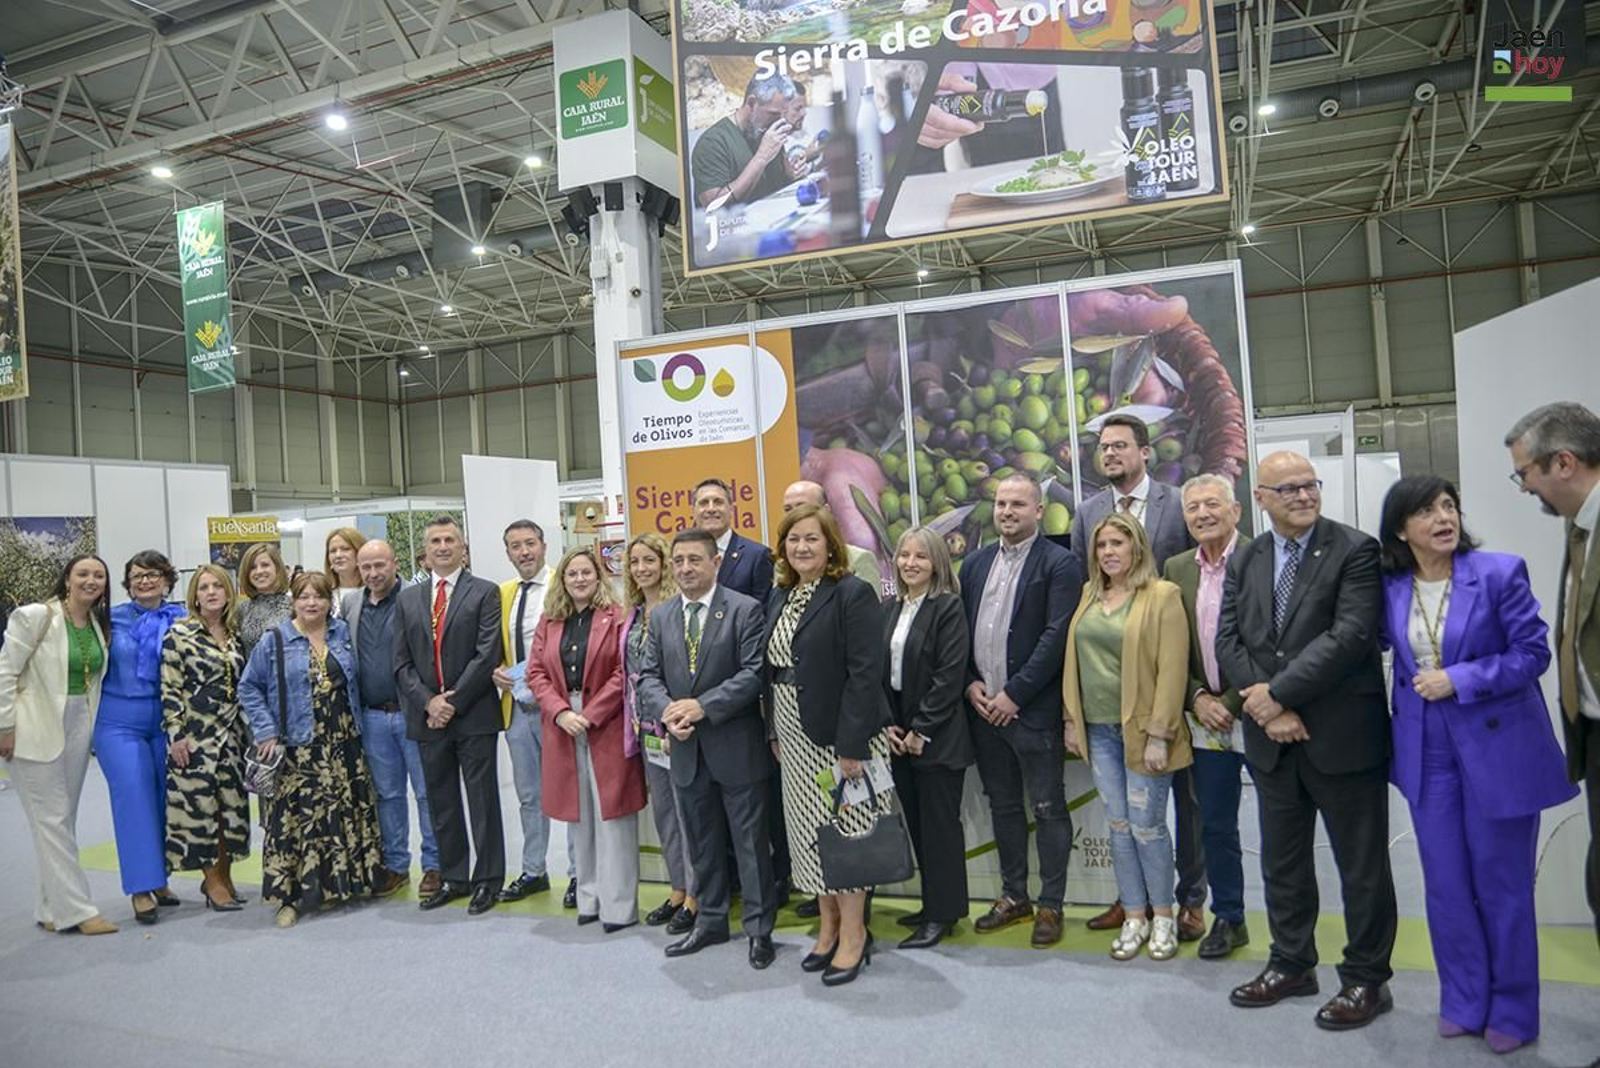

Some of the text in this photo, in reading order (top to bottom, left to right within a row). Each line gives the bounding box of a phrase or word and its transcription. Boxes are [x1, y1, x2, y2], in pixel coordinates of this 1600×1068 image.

[753, 0, 1107, 82] Sierra de Cazorla
[589, 95, 625, 112] RURAL
[1144, 135, 1195, 155] OLEO
[1147, 150, 1196, 169] TOUR
[642, 414, 693, 428] Tiempo
[632, 428, 693, 444] de Olivos
